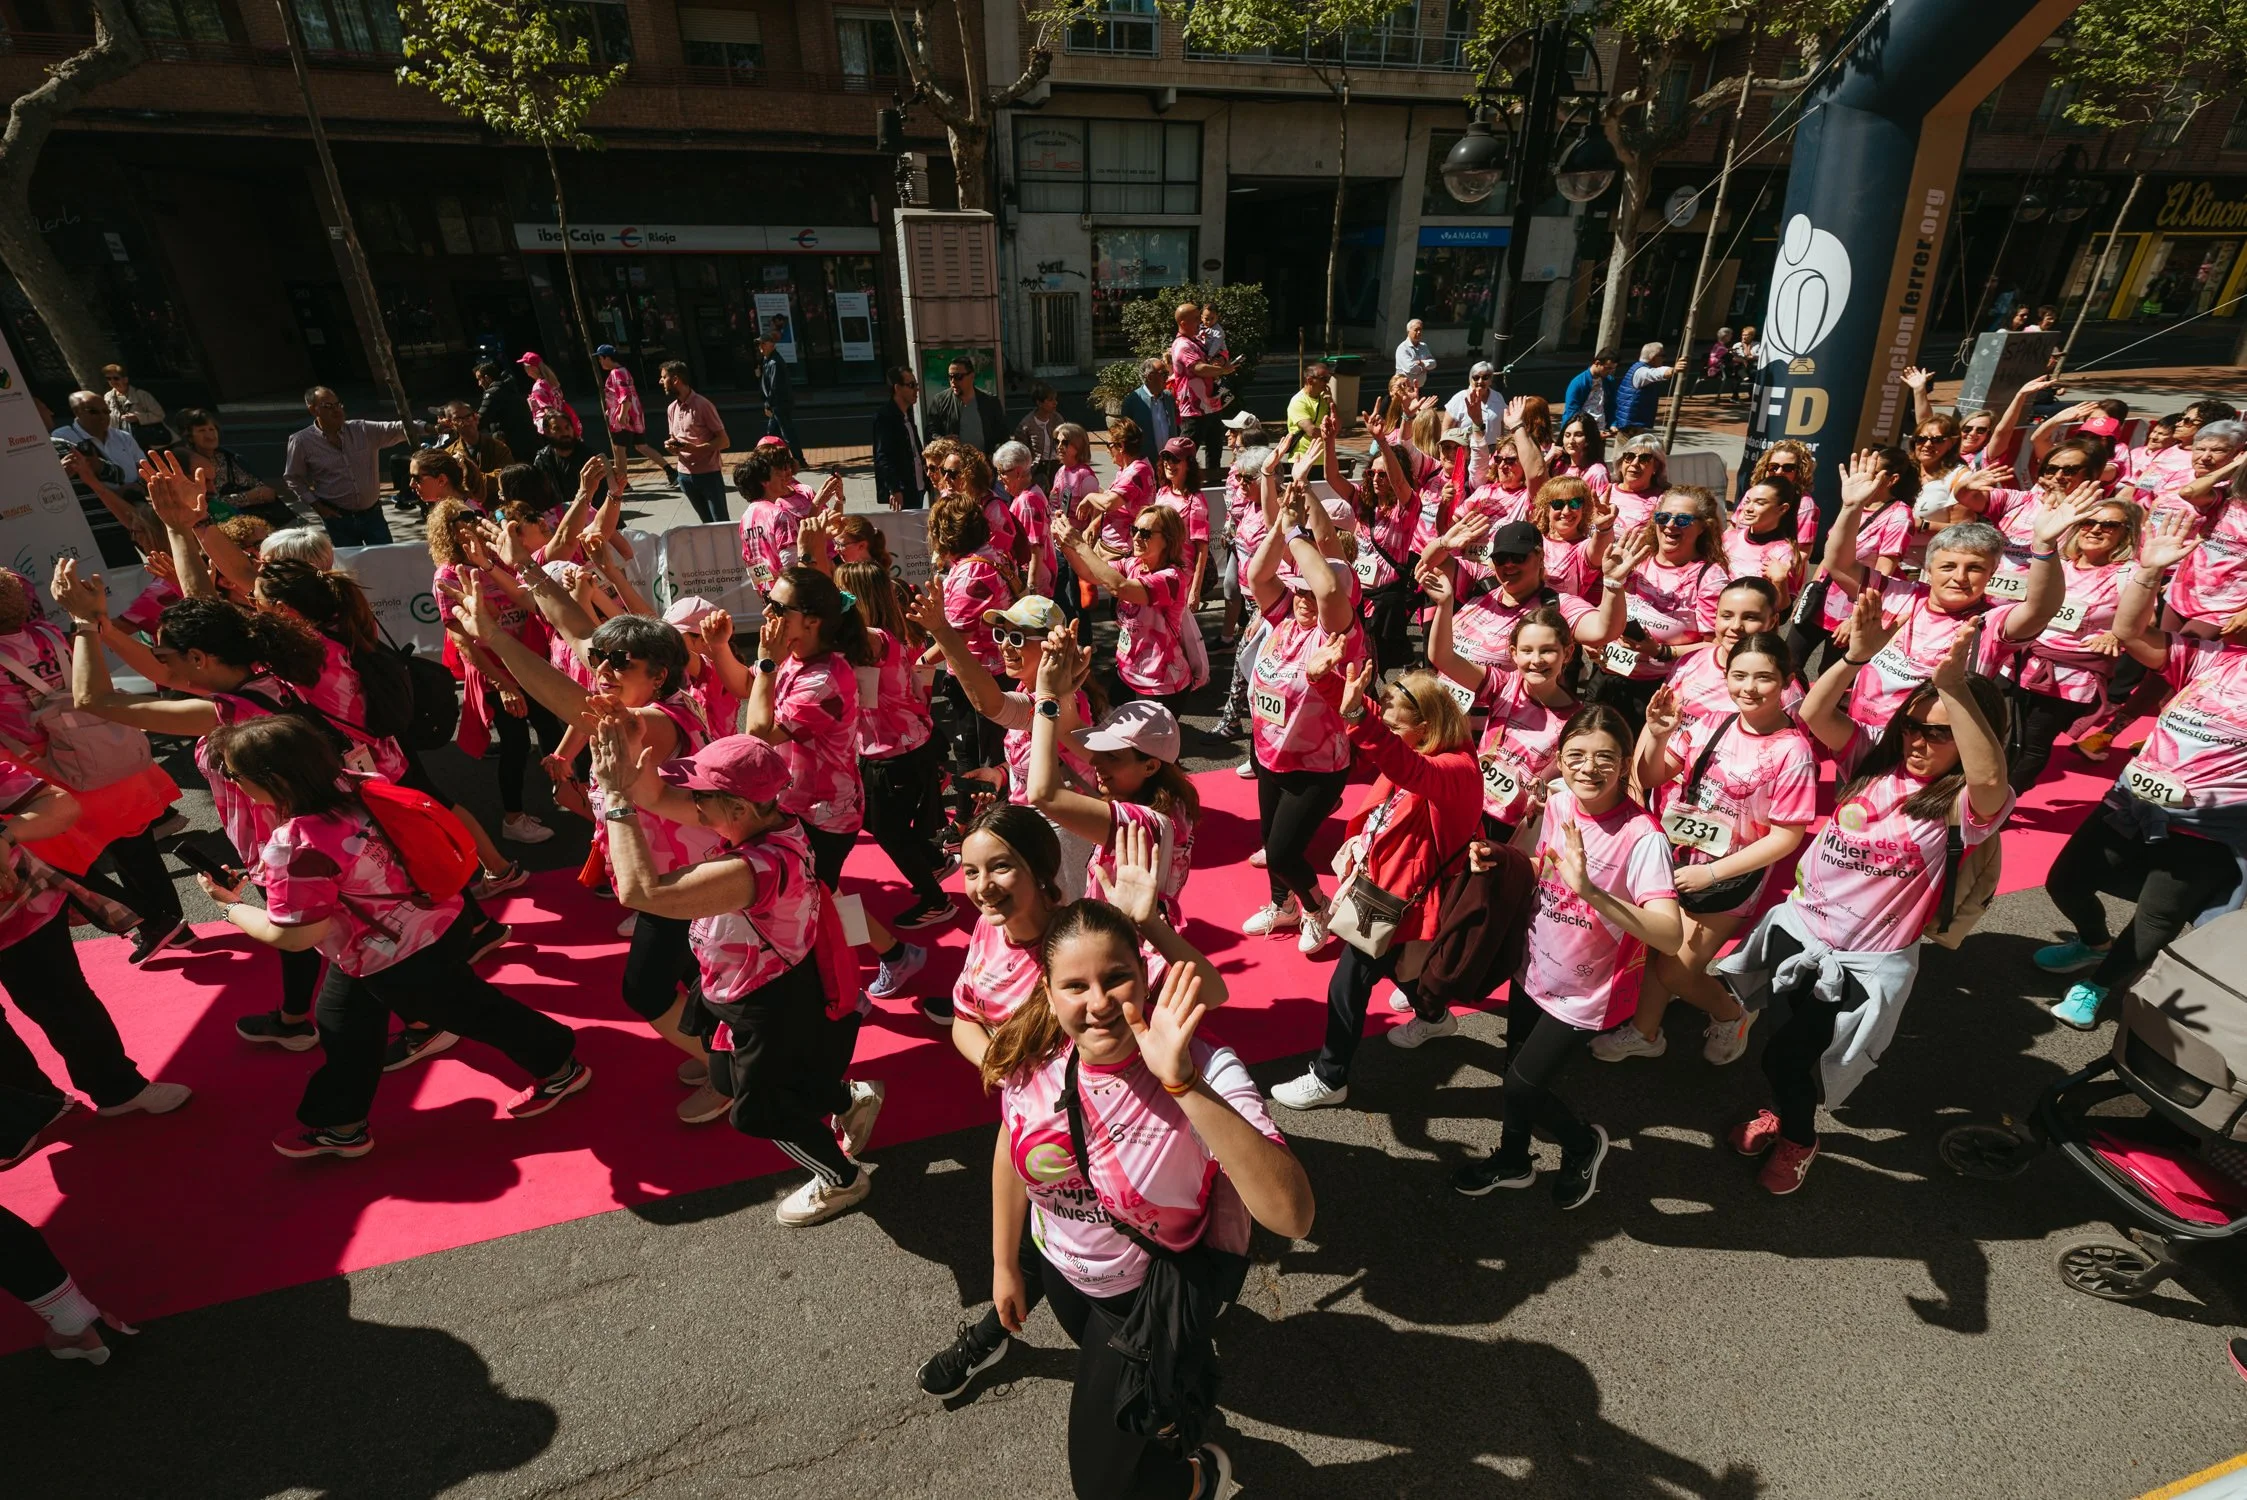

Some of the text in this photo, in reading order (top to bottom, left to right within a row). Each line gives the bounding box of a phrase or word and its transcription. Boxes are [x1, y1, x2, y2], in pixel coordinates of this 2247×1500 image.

[537, 228, 677, 245] ibeCaja Rioja
[1752, 383, 1829, 436] FD
[683, 578, 706, 586] contra
[1606, 645, 1634, 667] 0434
[1880, 649, 1901, 662] por
[2168, 711, 2202, 727] por la
[1480, 760, 1515, 792] 9979
[2131, 773, 2174, 803] 9981
[1672, 816, 1719, 842] 7331
[1824, 832, 1871, 859] Mujer
[1874, 853, 1903, 865] por
[1875, 838, 1898, 851] de
[1903, 840, 1921, 853] la
[1821, 849, 1918, 879] Investigación
[1121, 1190, 1146, 1210] la
[1071, 1256, 1089, 1274] Rioja
